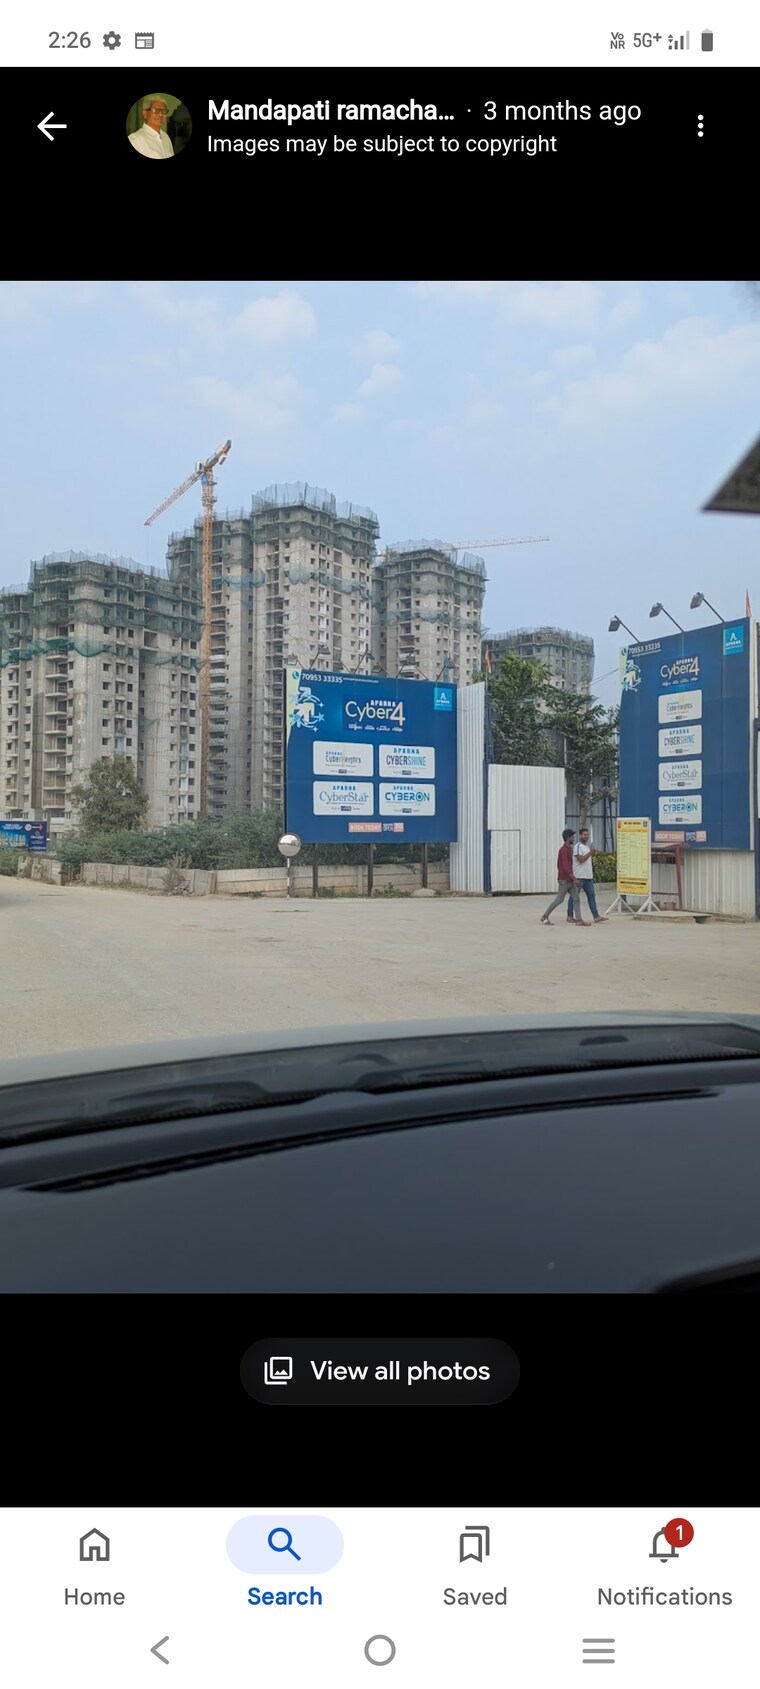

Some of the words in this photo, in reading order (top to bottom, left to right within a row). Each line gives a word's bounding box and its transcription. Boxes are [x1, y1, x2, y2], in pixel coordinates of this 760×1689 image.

[628, 645, 644, 654] 70953
[644, 642, 660, 651] 33335
[660, 656, 700, 679] Cyber4
[301, 673, 322, 682] 70953
[323, 674, 343, 684] 33335
[370, 699, 396, 707] APARNA
[345, 700, 406, 726] Cyber4
[664, 734, 695, 746] CYBERSHINE
[386, 754, 426, 766] CYBERSHINE
[663, 769, 698, 780] CyberStar
[320, 791, 369, 803] CyberStar
[385, 791, 430, 802] CYBERON
[663, 802, 697, 812] CYBERON
